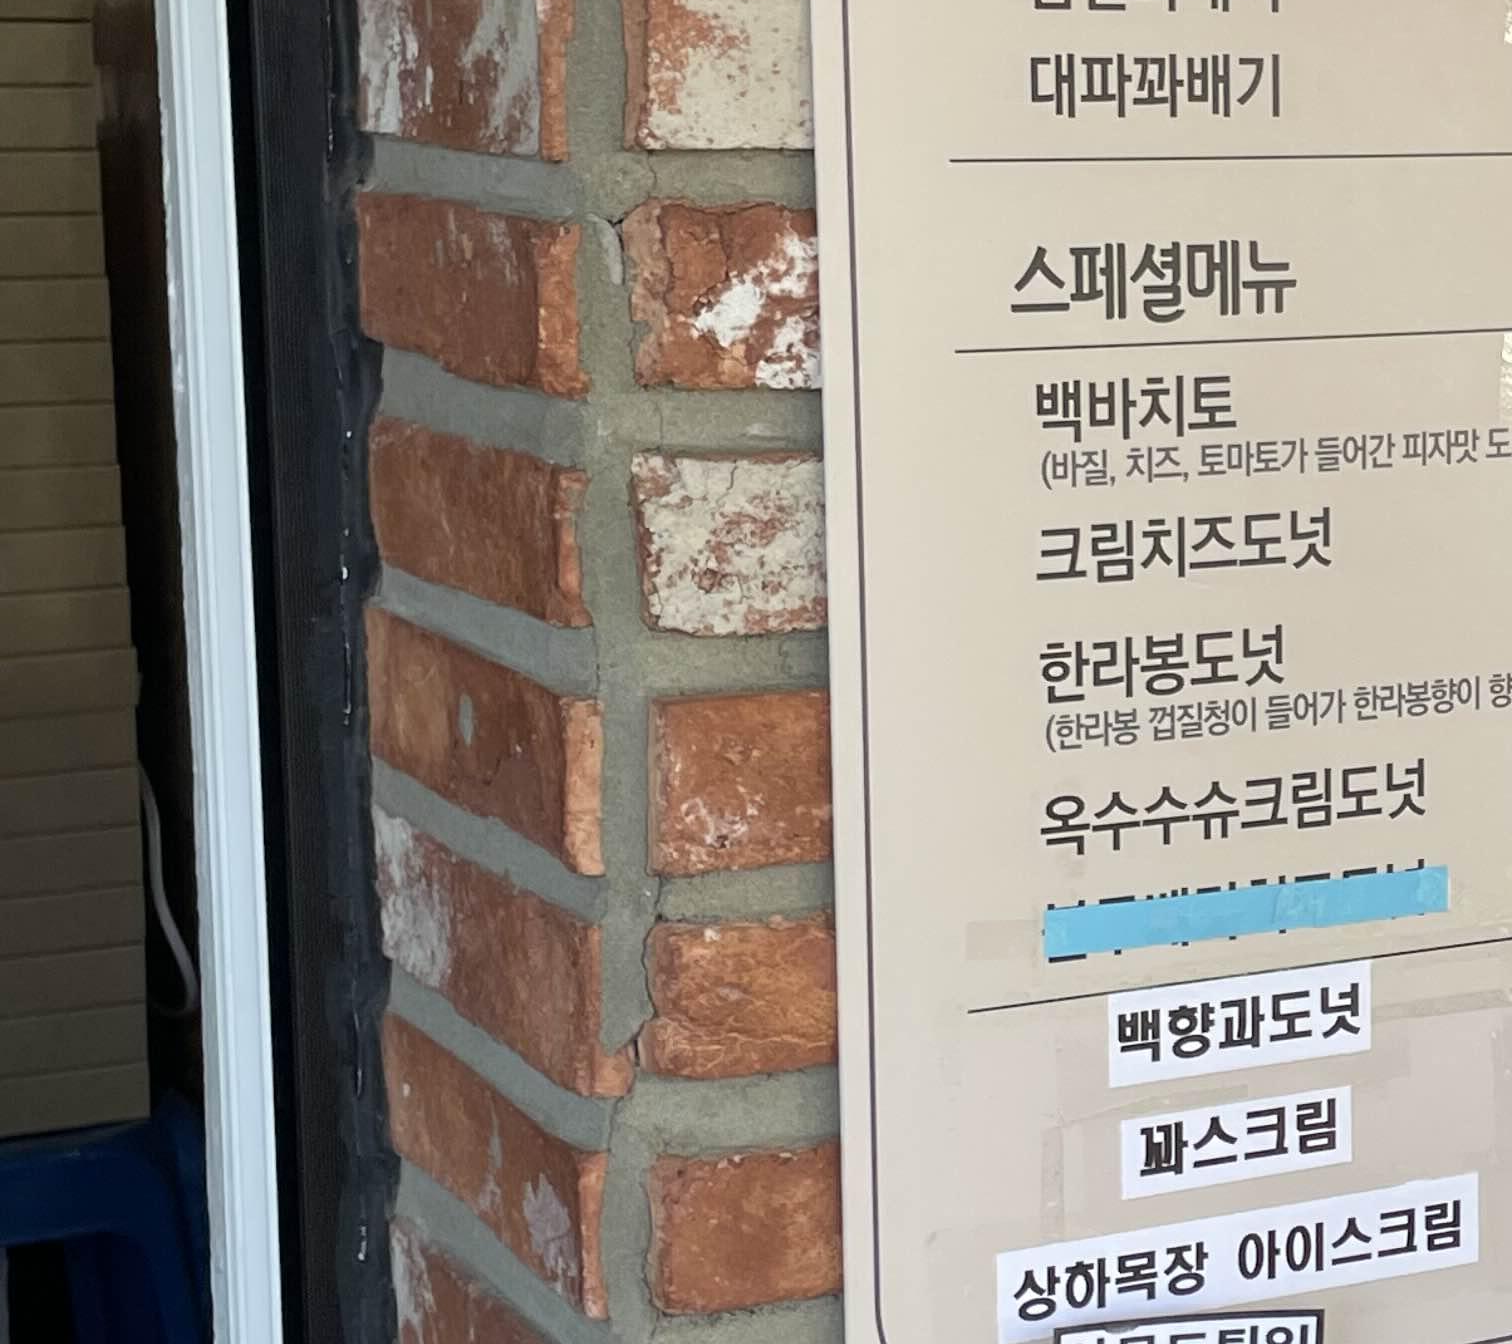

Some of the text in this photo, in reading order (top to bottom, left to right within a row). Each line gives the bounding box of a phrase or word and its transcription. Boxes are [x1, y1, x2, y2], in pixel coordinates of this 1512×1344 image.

[1031, 53, 1279, 118] 대파꽈배기
[1011, 240, 1296, 323] 스페셜메뉴
[1036, 376, 1237, 443] 백바치토
[1042, 449, 1115, 490] (바질,
[1126, 447, 1189, 483] 치즈,
[1198, 438, 1308, 477] 토마토가
[1314, 433, 1395, 472] 들어간
[1402, 429, 1480, 466] 피자맛
[1037, 507, 1331, 583] 크림치즈도넛
[1039, 623, 1286, 705] 한라봉도넛
[1046, 708, 1140, 752] (한라봉
[1149, 697, 1256, 741] 껍질청이
[1265, 689, 1346, 730] 들어가
[1353, 676, 1480, 720] 한라봉향이
[1041, 758, 1425, 855] 옥수수슈크림도넛
[1118, 983, 1360, 1062] 백향과도넛
[1140, 1098, 1336, 1176] 꽈스크림
[1014, 1200, 1460, 1321] 상하목장 아이스크림
